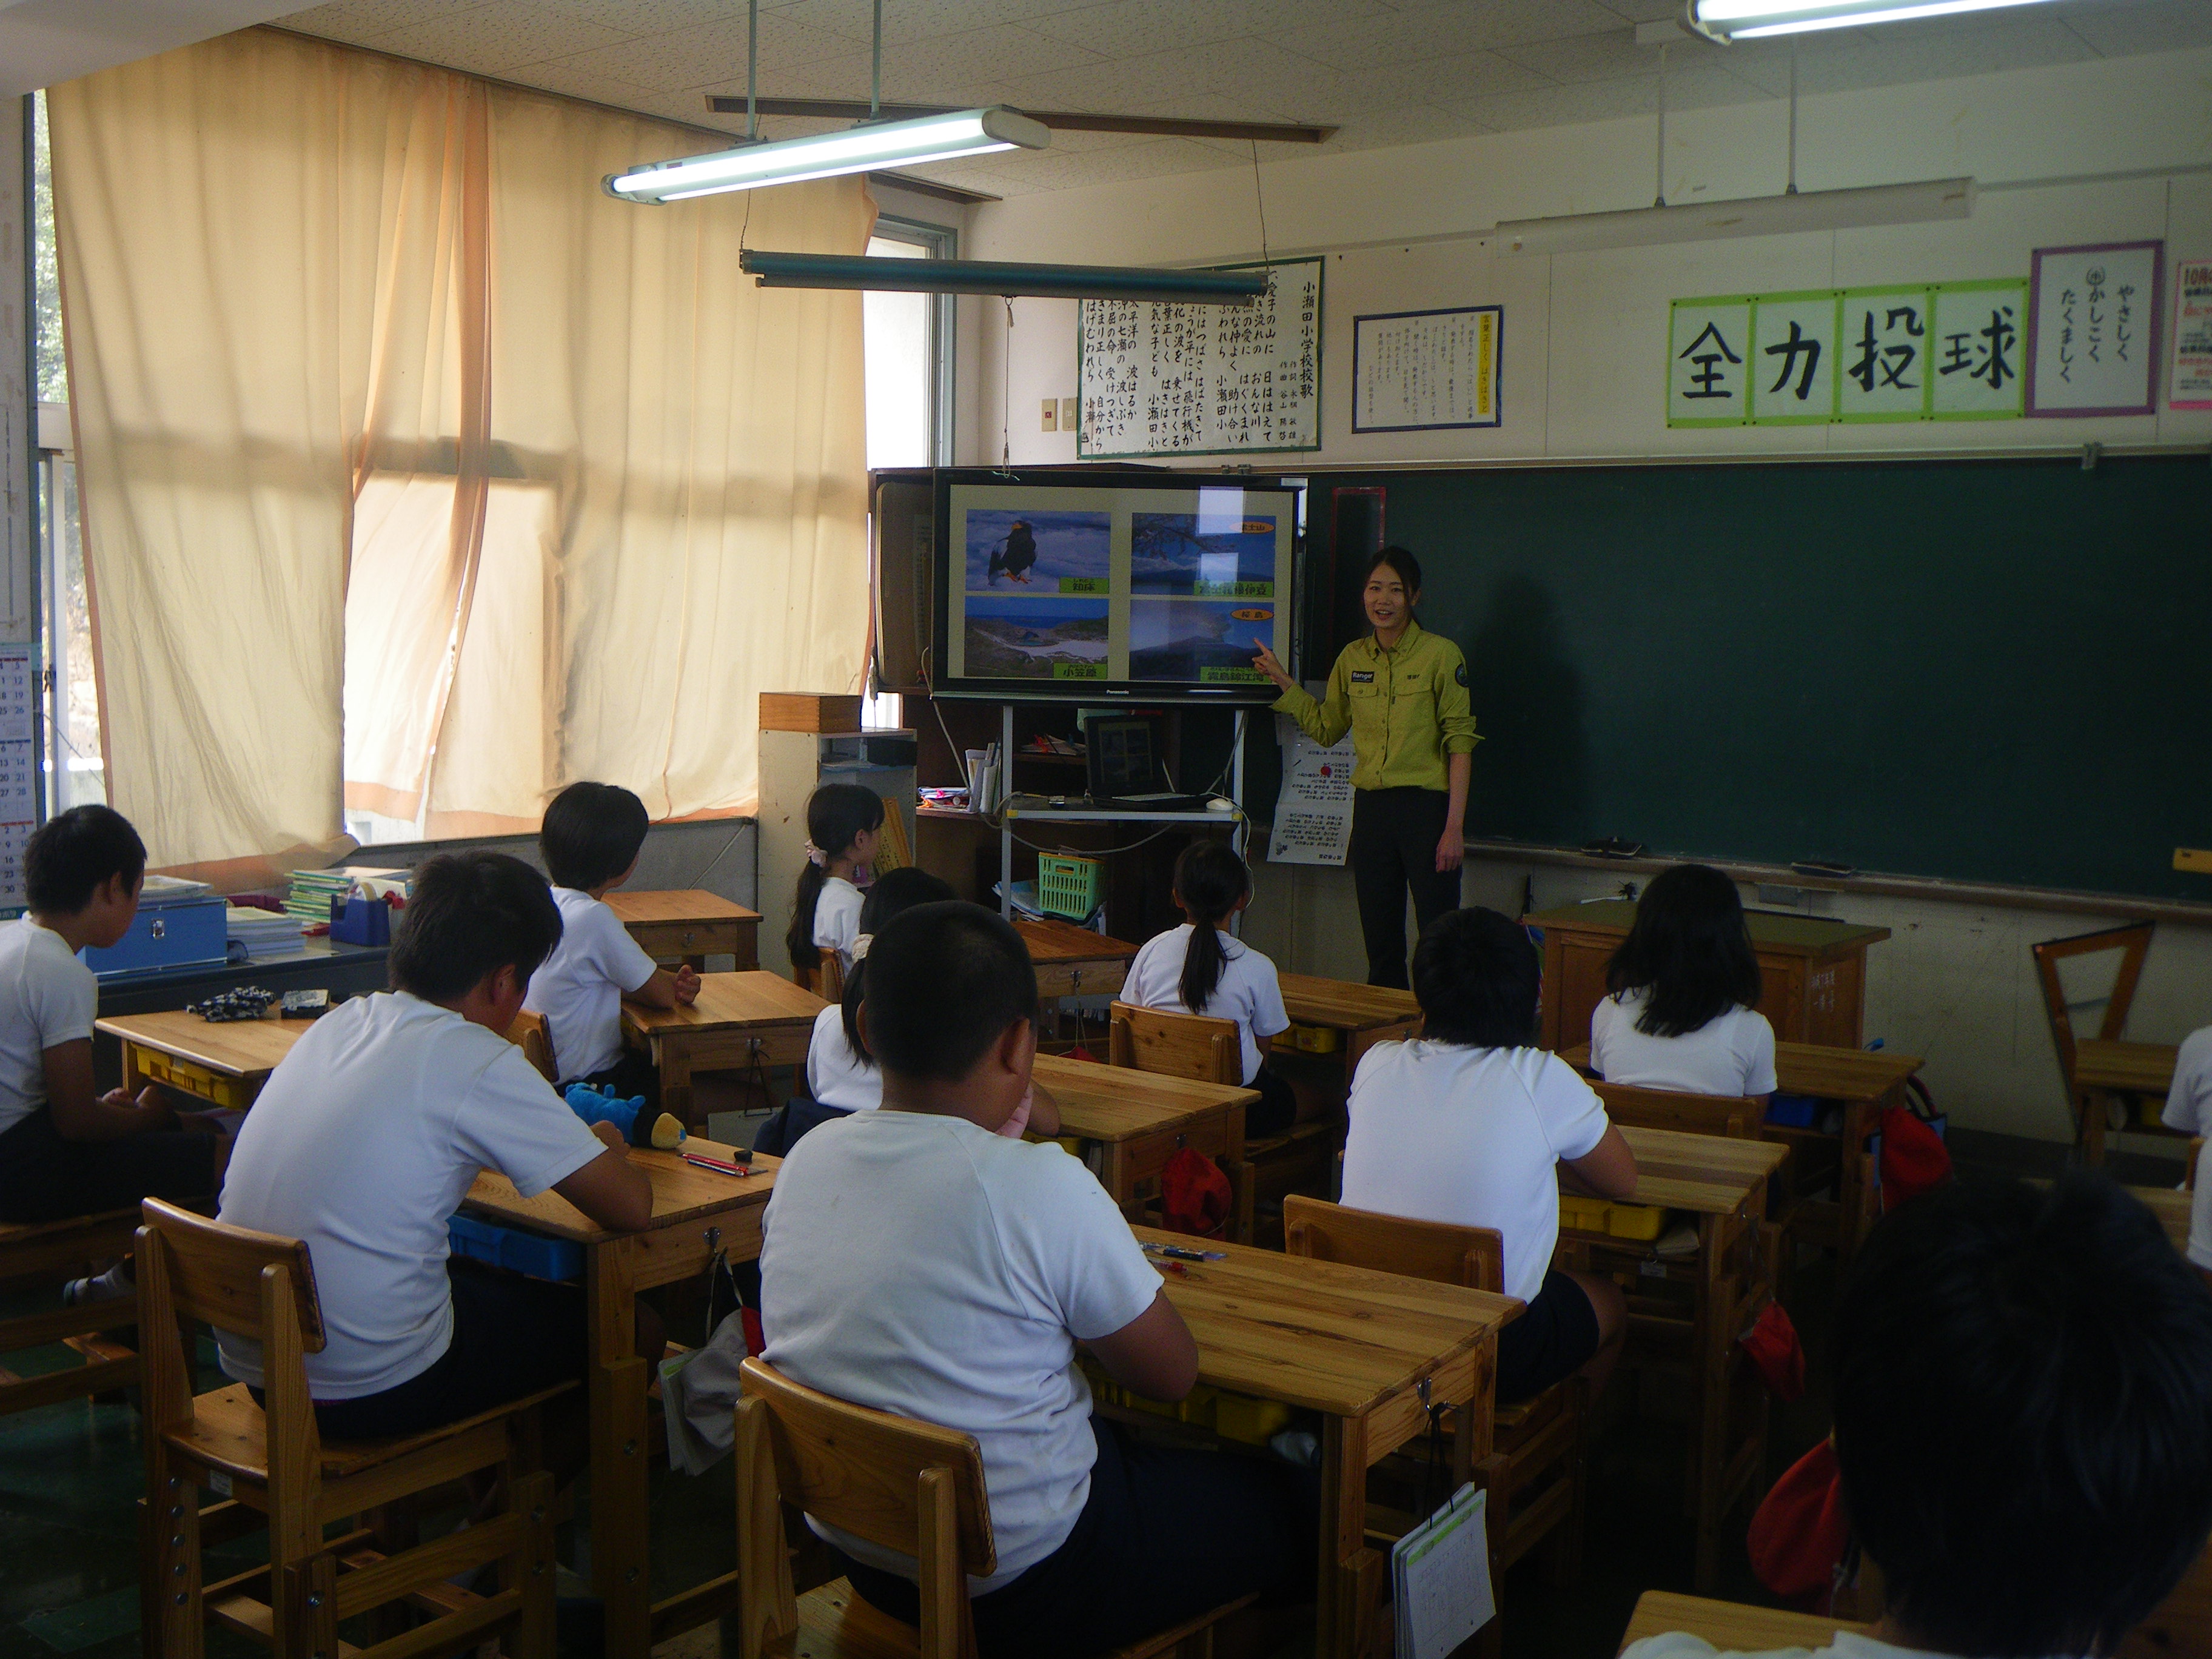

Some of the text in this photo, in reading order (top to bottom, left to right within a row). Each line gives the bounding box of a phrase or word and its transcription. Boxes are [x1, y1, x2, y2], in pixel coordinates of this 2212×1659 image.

[1085, 300, 1097, 383] はげむわれら
[1299, 281, 1315, 399] 小瀬田小学校校歌
[2060, 288, 2076, 384] たくましく
[2117, 285, 2135, 362] やさしく
[1171, 303, 1185, 447] 化の波を 乗せてくる
[1251, 294, 1265, 428] き流れの おんな川
[1279, 361, 1287, 381] 作曲
[1678, 306, 2016, 401] 全力投球
[1105, 366, 1116, 437] 受けつぎて
[1116, 380, 1127, 436] 波しぶき
[1127, 364, 1138, 420] 波はるか
[1161, 379, 1171, 447] はきはきと
[1181, 390, 1194, 446] 飛行機が
[1195, 377, 1205, 442] はばたきて
[1216, 375, 1227, 430] 小瀬田小
[1228, 387, 1238, 443] 助け合い
[1239, 373, 1250, 444] はぐくまれ
[1263, 370, 1273, 441] 日ははえて
[1279, 390, 1287, 409] 谷山
[1095, 395, 1105, 451] 自分から
[1148, 394, 1159, 447] 小瀬田小
[1072, 582, 1096, 592] 知床
[14, 676, 23, 685] 12
[1063, 667, 1097, 677] 小笠原
[16, 773, 25, 782] 21
